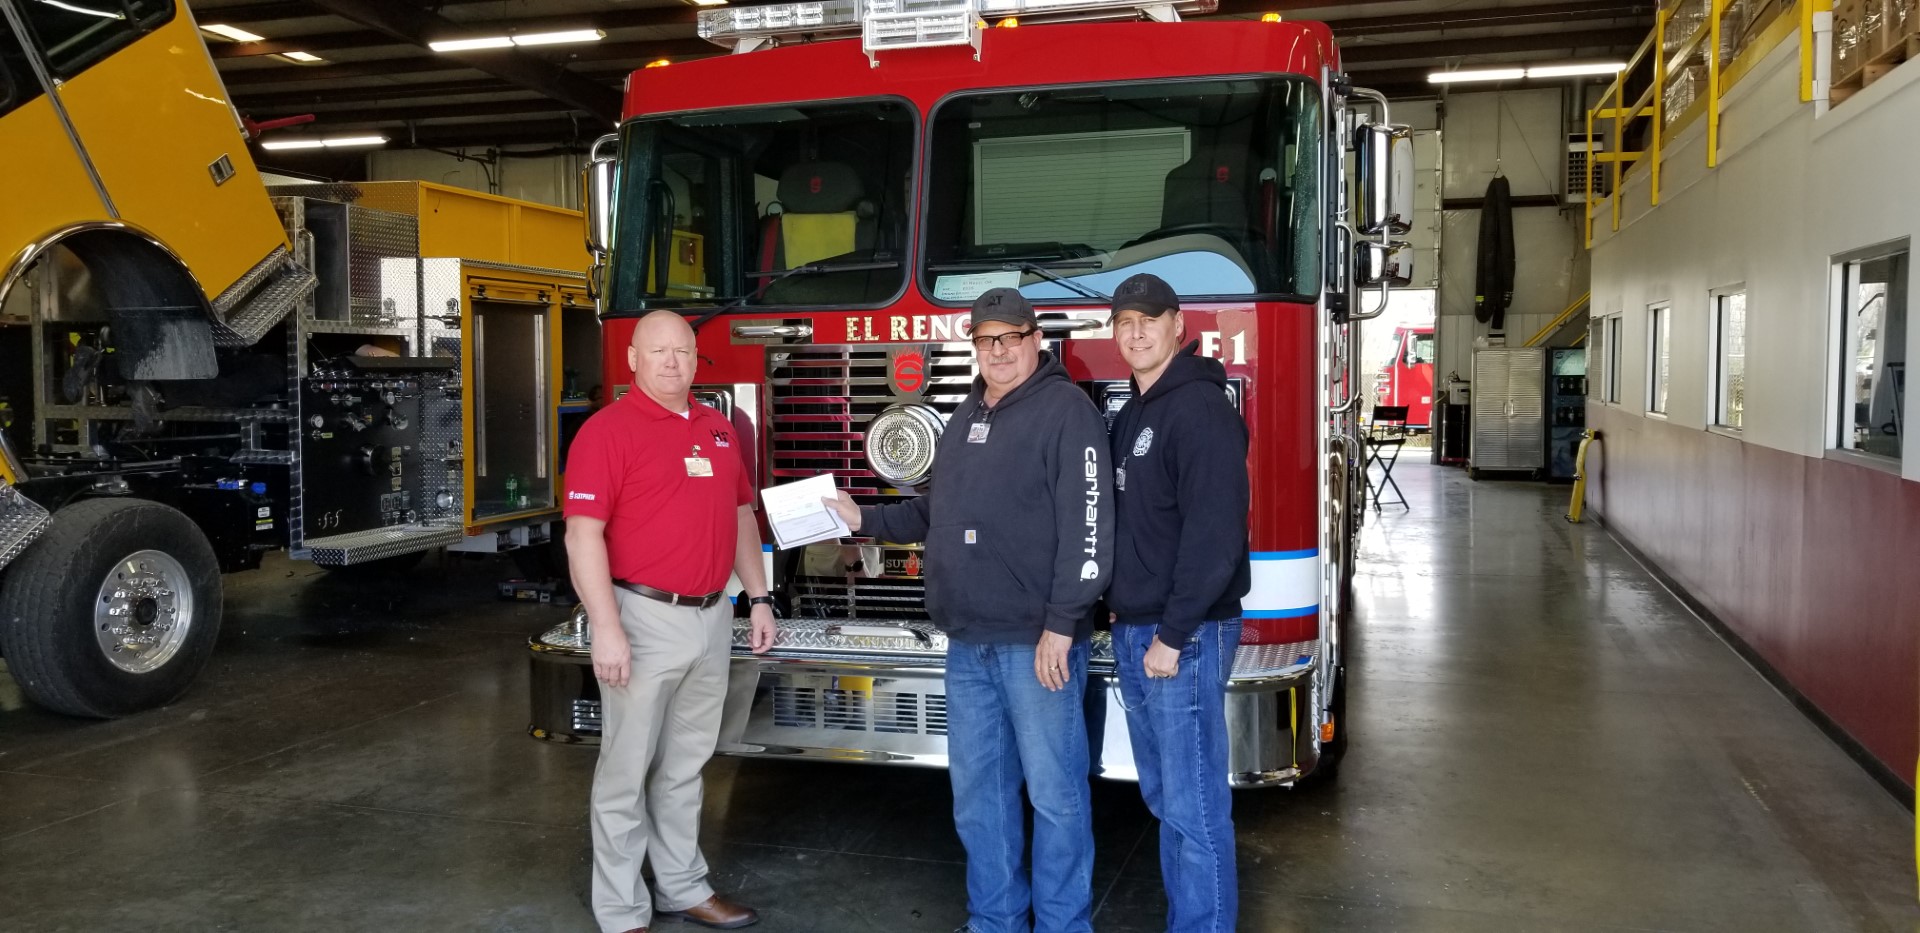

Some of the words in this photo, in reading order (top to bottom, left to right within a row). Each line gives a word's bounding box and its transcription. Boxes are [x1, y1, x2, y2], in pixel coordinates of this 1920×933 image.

[846, 316, 879, 341] EL
[1084, 446, 1100, 557] carhartt
[885, 558, 923, 569] SUTPH
